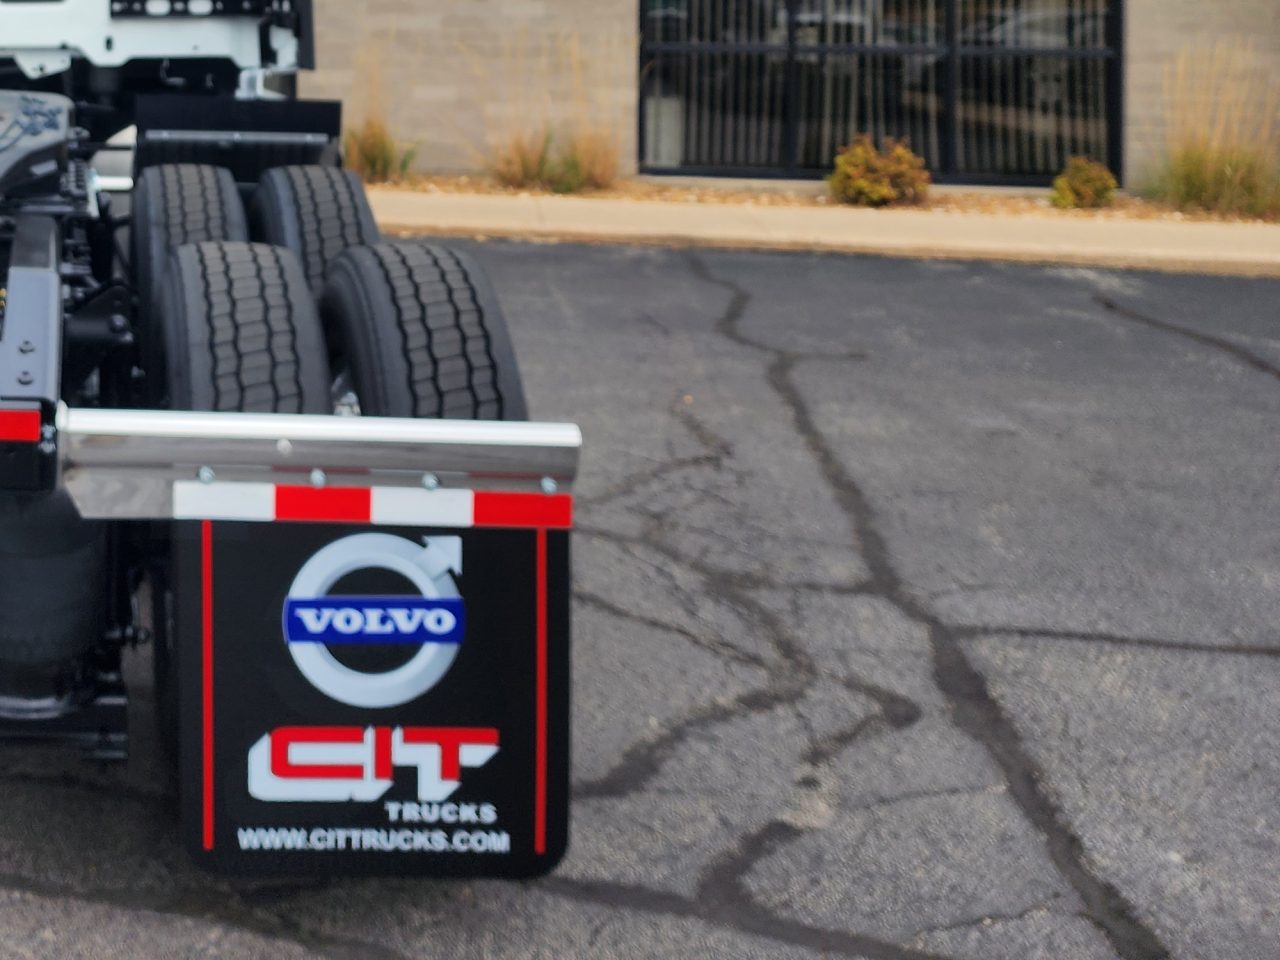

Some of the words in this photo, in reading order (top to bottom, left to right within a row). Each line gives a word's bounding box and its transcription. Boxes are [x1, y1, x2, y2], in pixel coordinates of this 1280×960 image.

[295, 608, 456, 635] VOLVO
[247, 725, 500, 803] CIT
[384, 801, 497, 823] TRUCKS
[237, 827, 511, 853] WWW.CITTRUCKS.COM
